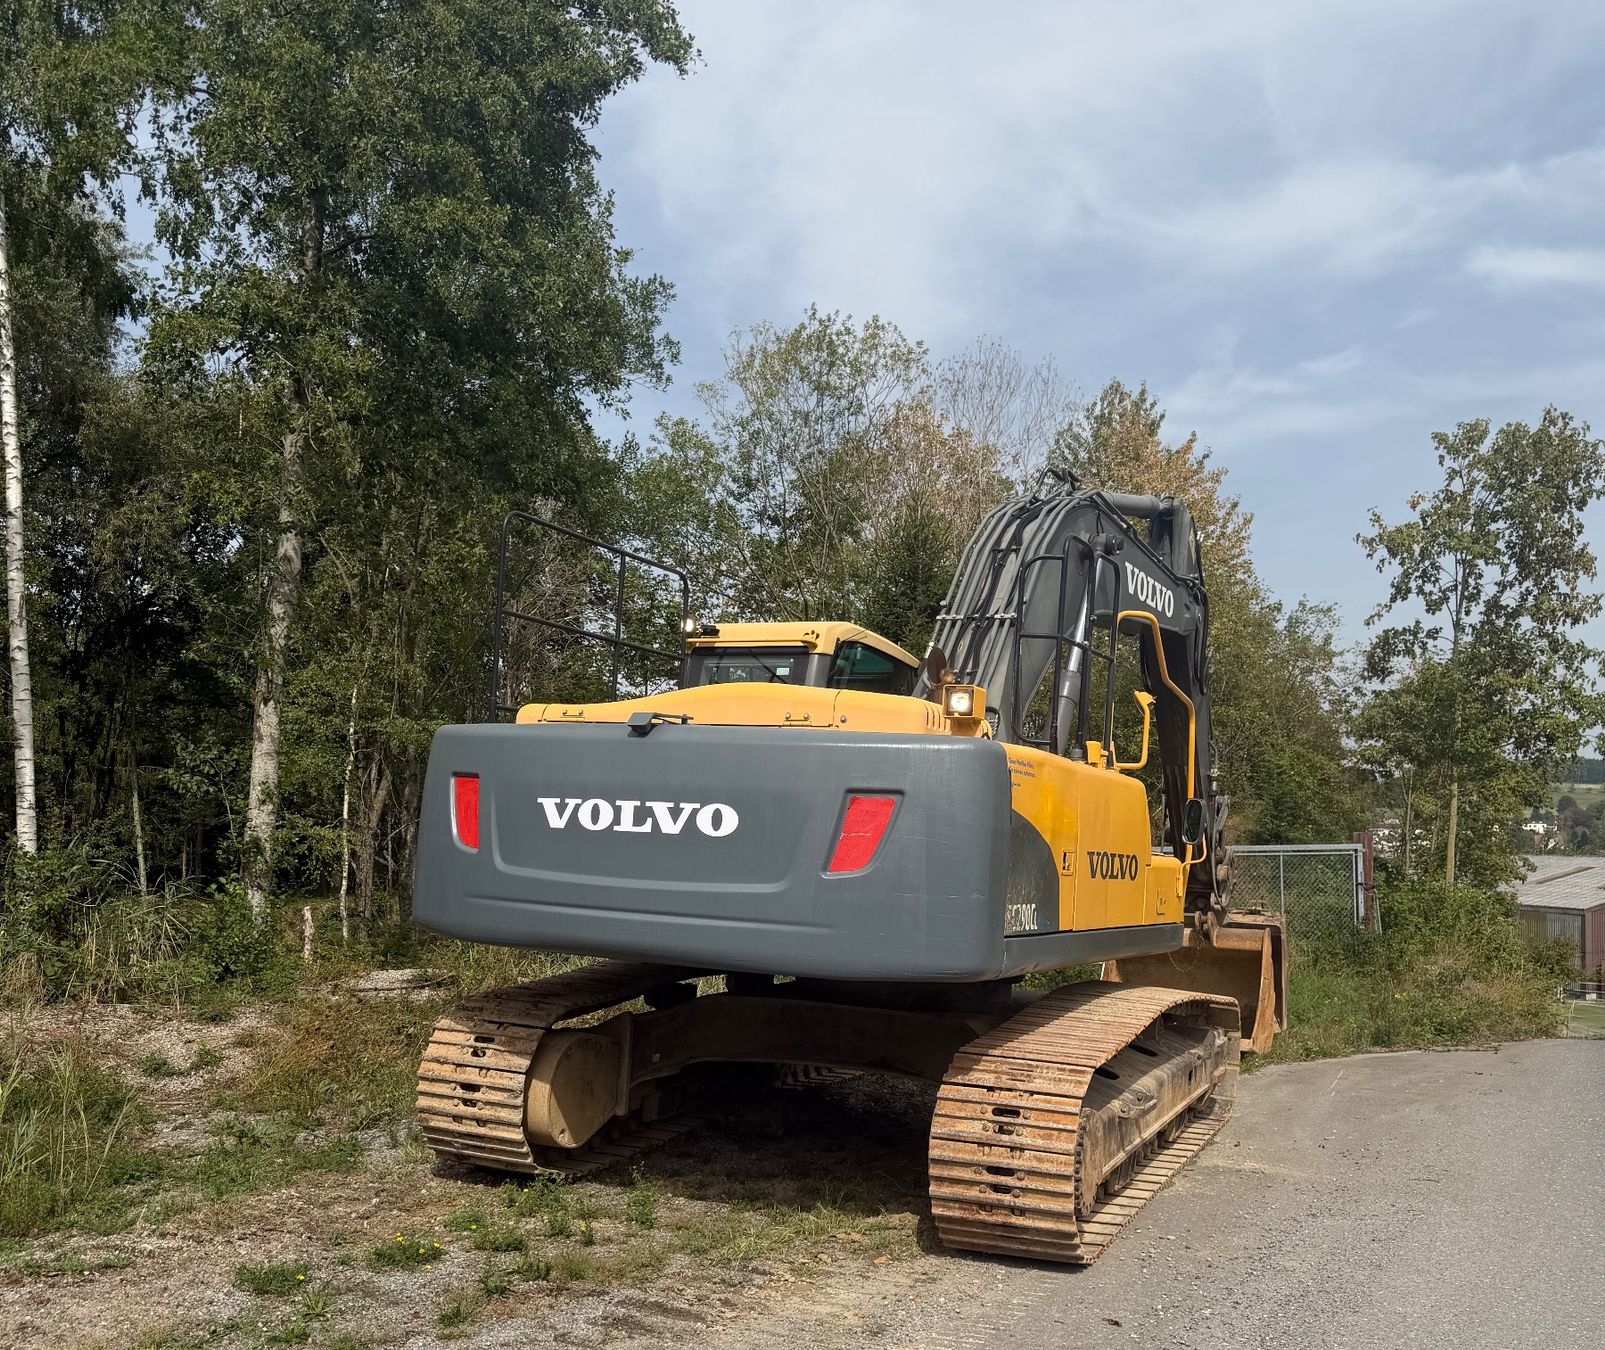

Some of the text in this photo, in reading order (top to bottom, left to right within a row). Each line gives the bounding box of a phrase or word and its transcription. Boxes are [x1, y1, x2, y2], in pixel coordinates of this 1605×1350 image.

[1125, 561, 1174, 618] VOLVO
[537, 797, 739, 837] VOLVO
[1087, 851, 1138, 881] VOLVO
